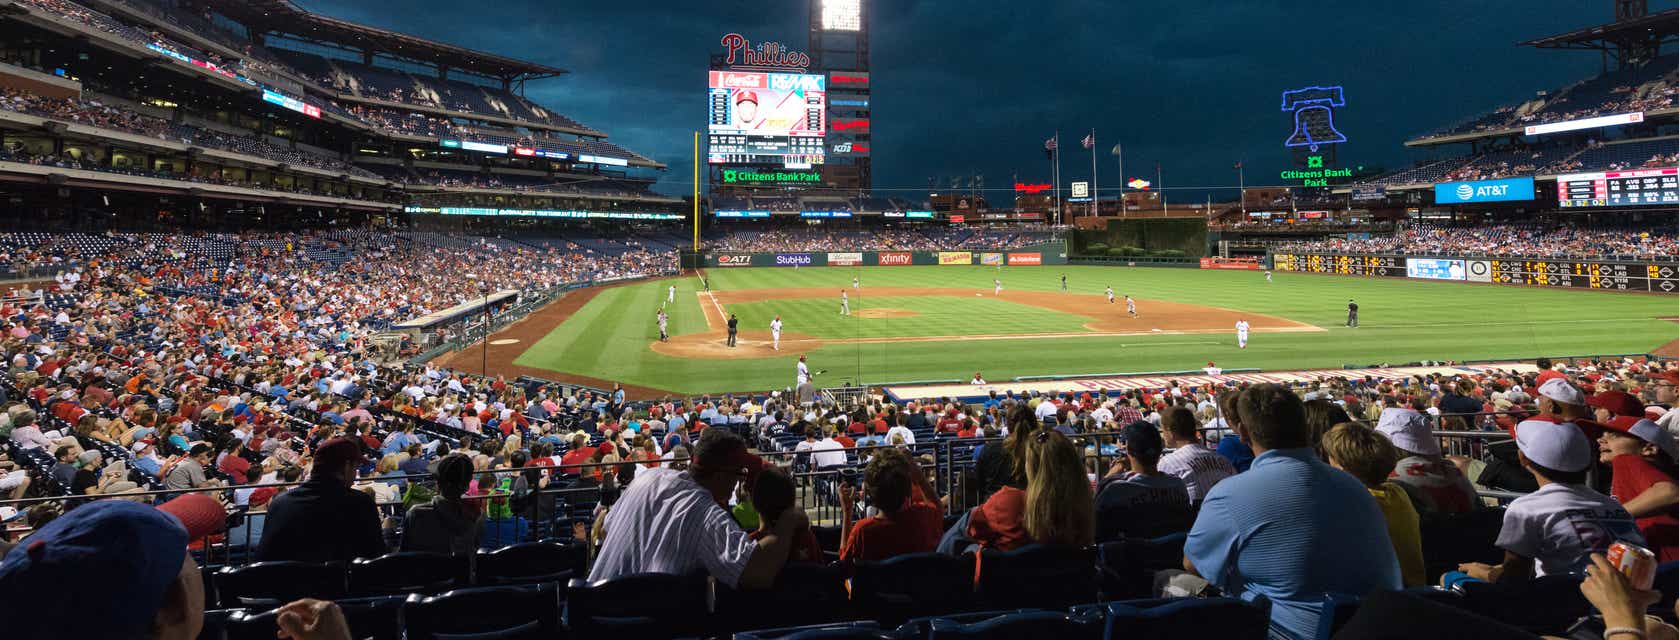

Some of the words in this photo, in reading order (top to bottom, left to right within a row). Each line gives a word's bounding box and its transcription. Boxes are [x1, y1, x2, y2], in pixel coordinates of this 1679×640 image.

[721, 33, 810, 69] Phillies
[738, 170, 775, 182] Citizens
[776, 170, 798, 182] Bank
[800, 170, 821, 182] Park
[1281, 170, 1322, 180] Citizens
[1324, 168, 1352, 177] Bank
[1304, 179, 1328, 187] Park
[1476, 184, 1509, 197] AT&T
[776, 255, 811, 264] StubHub
[881, 253, 910, 265] xfinity
